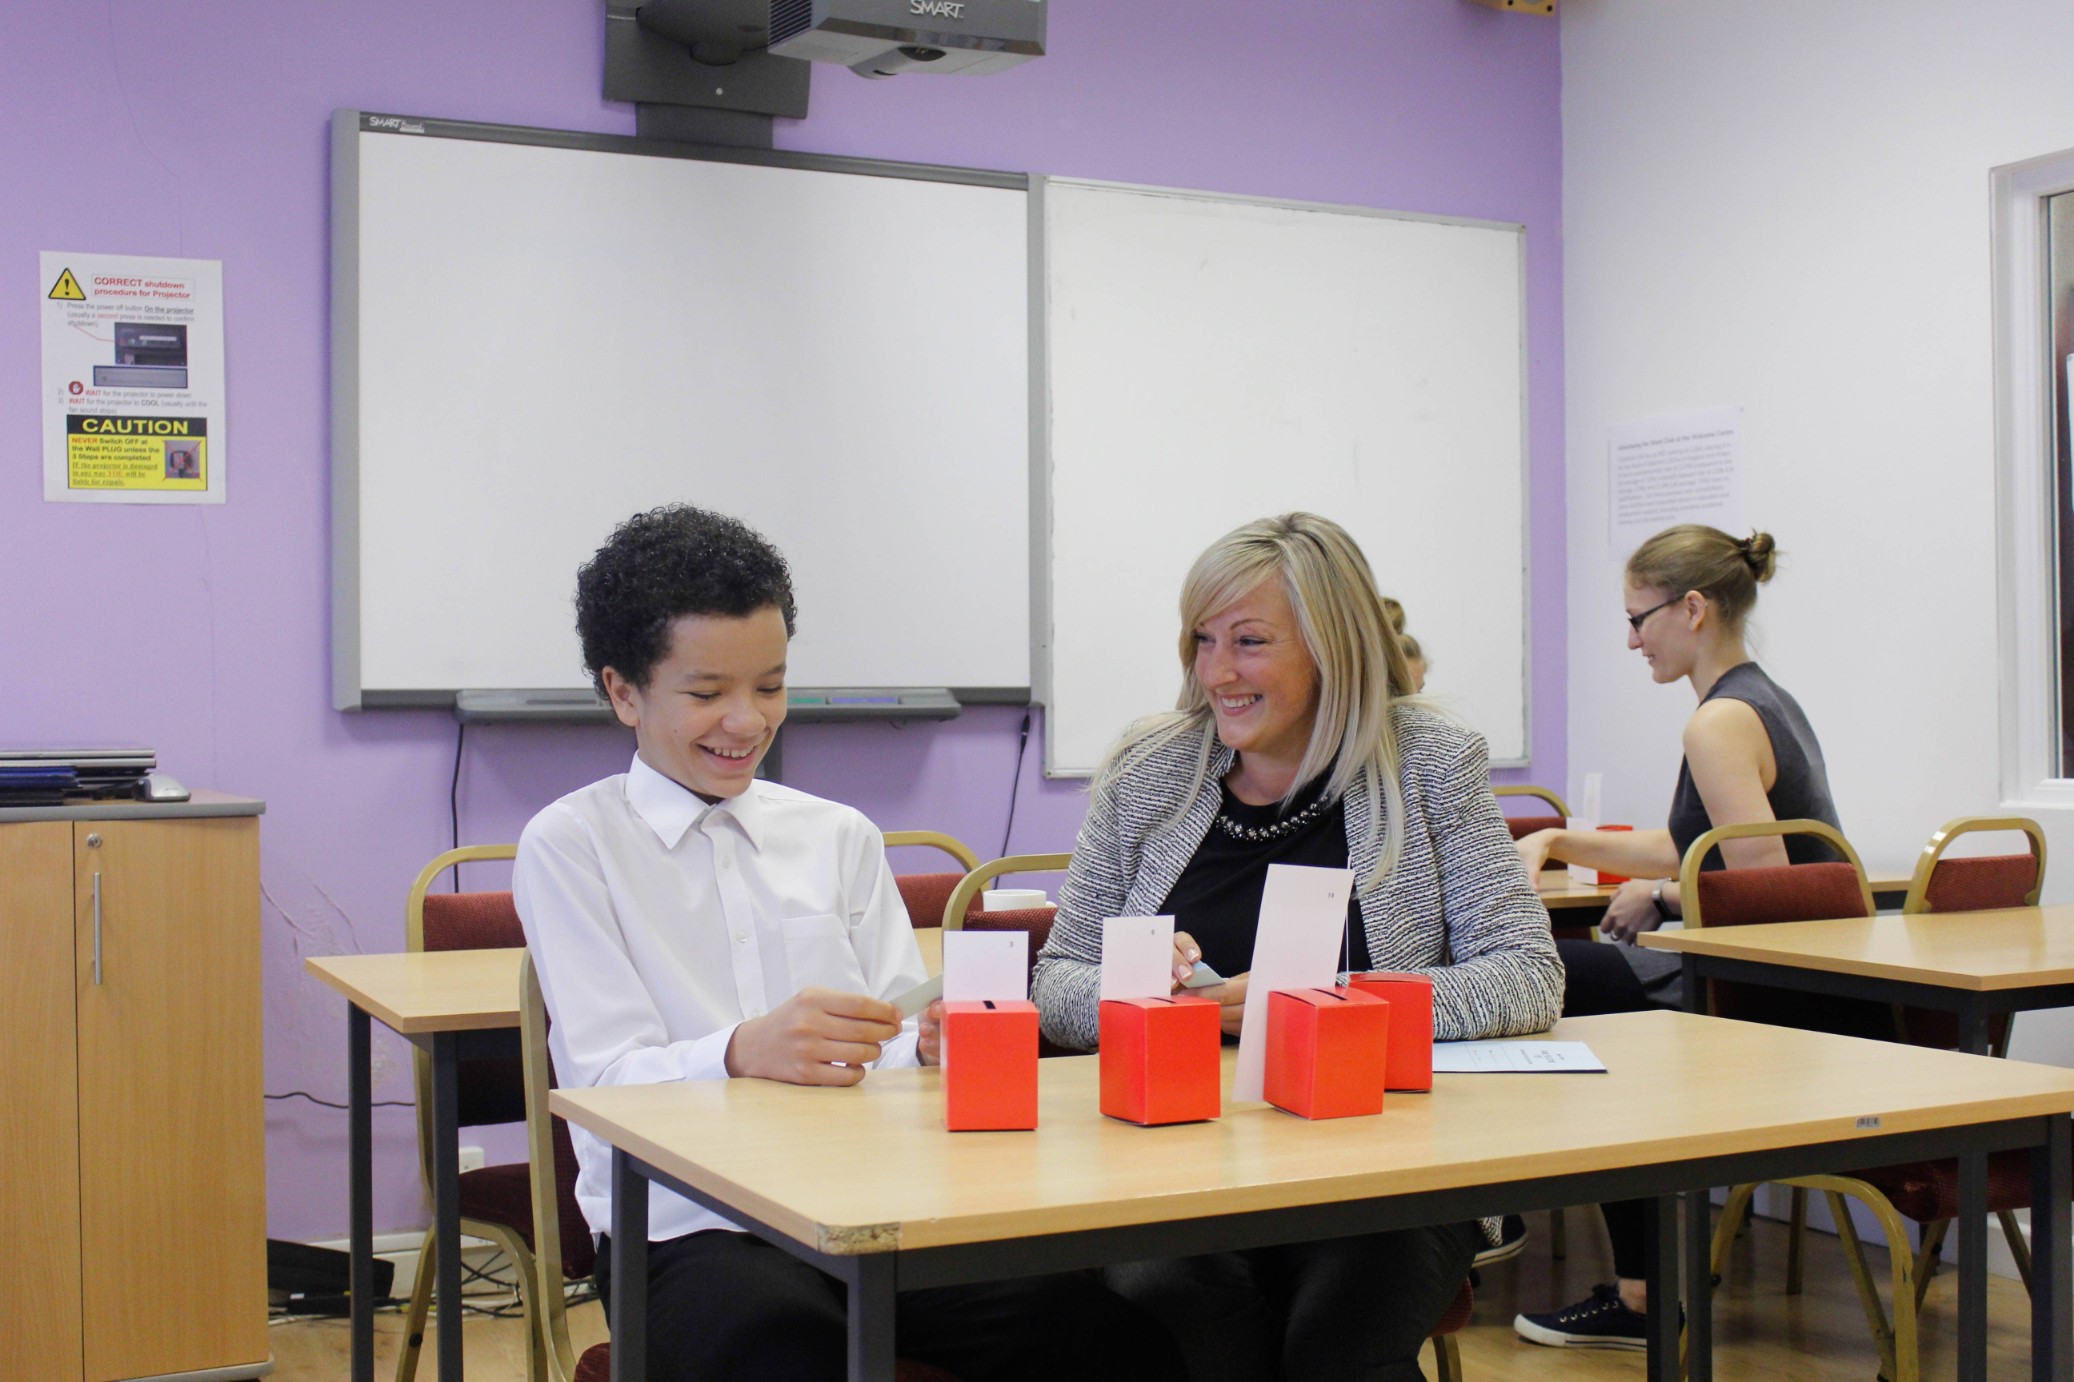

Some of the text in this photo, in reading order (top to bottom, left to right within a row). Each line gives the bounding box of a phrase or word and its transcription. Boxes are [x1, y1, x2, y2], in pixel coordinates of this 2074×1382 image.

[910, 0, 964, 18] SMART
[370, 116, 401, 128] SMART
[94, 277, 142, 287] CORRECT
[152, 290, 190, 299] Projector
[82, 419, 189, 434] CAUTION
